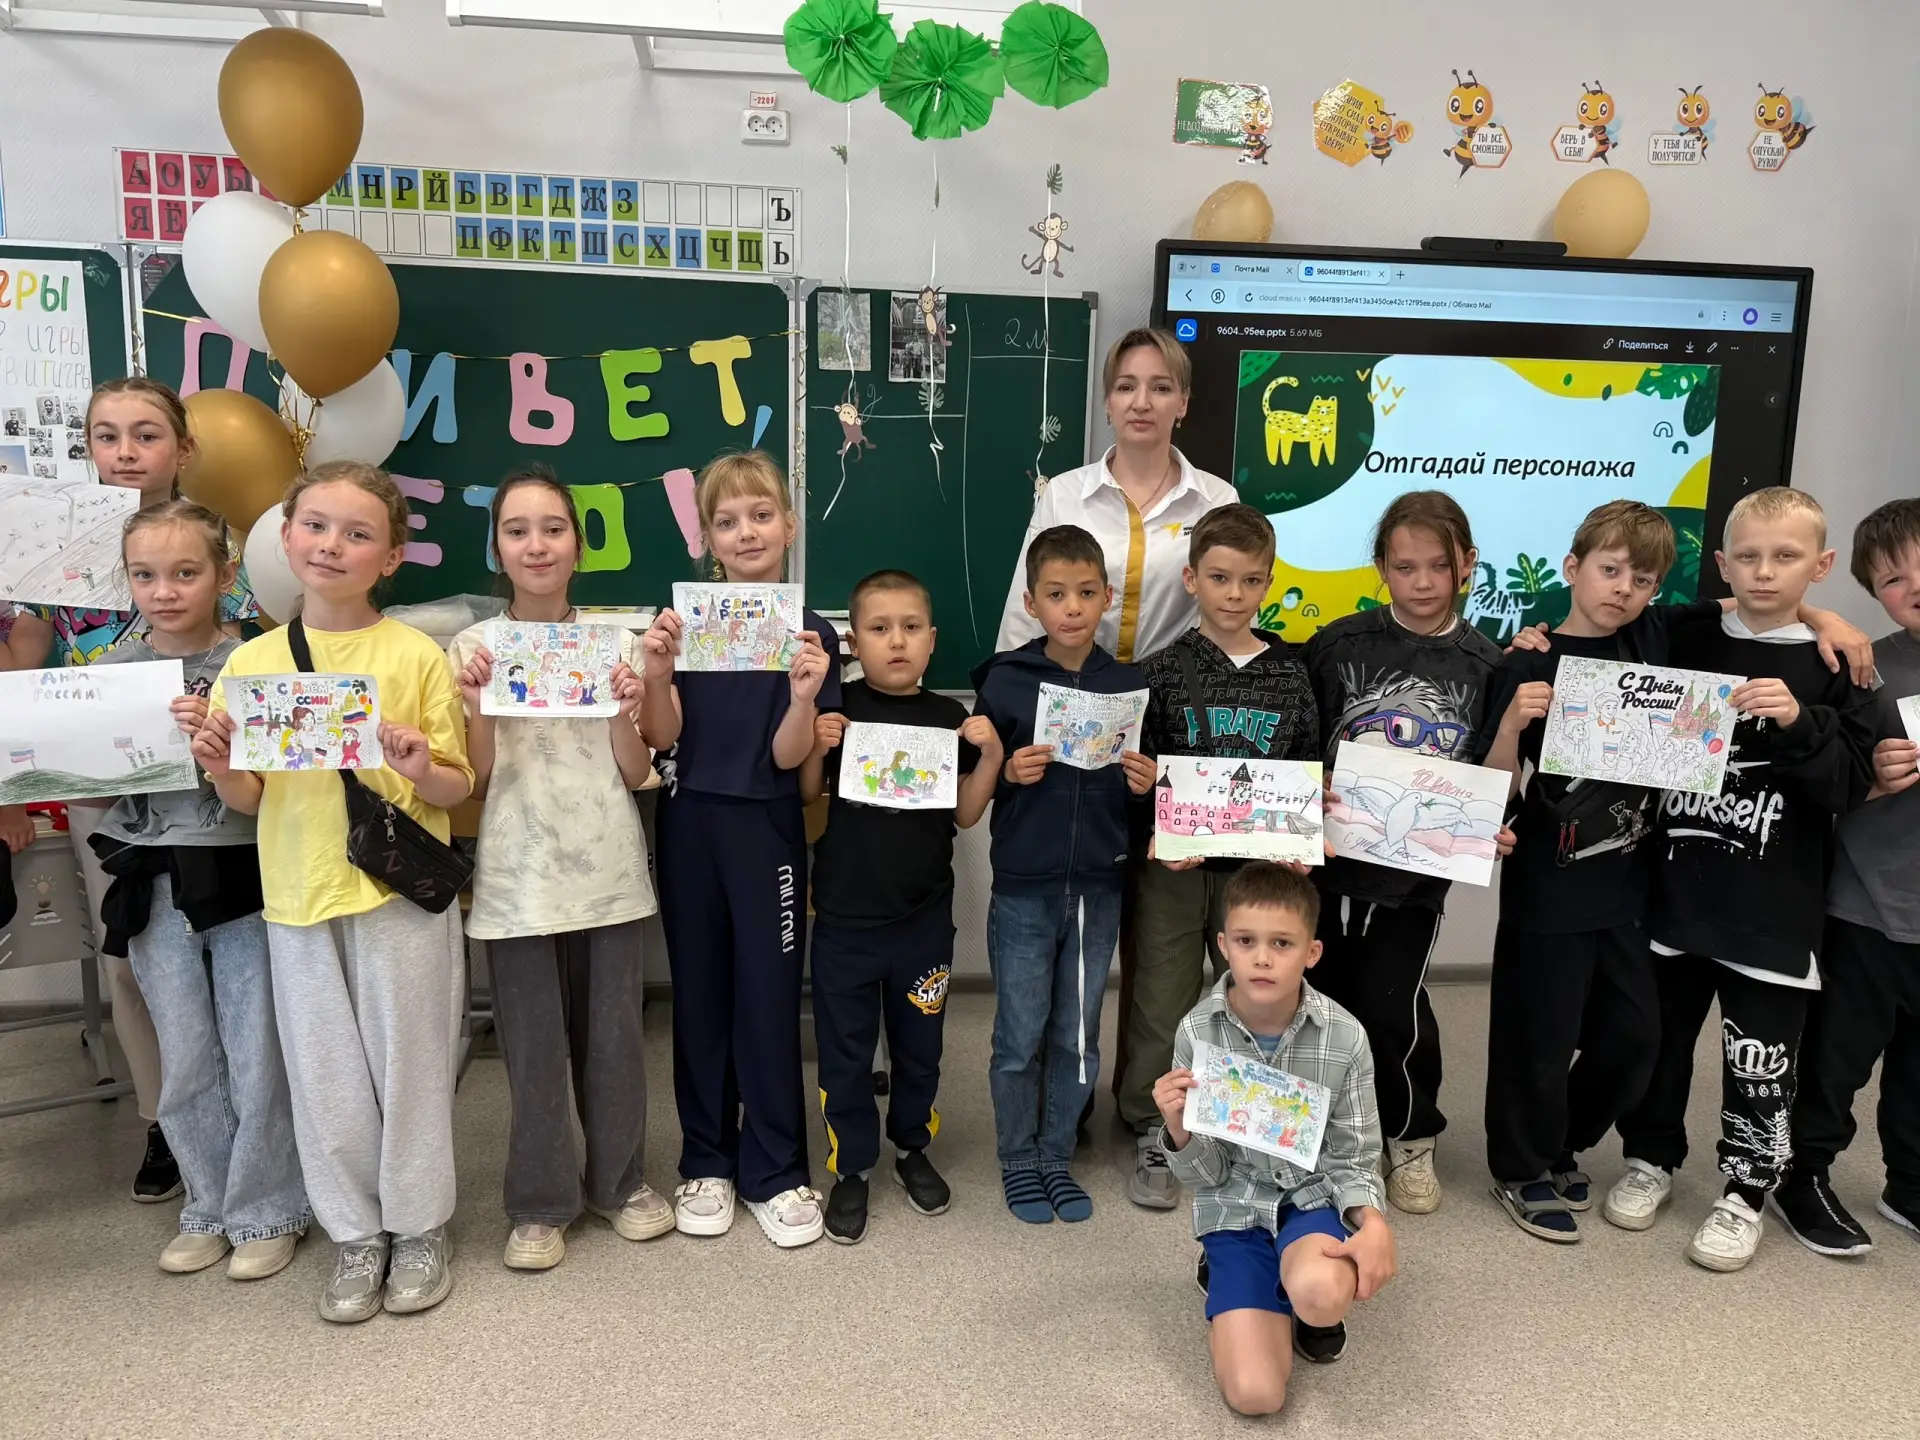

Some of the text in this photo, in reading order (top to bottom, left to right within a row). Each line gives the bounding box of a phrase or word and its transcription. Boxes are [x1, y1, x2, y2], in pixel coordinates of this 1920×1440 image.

[1478, 133, 1488, 143] ТЫ
[1560, 133, 1586, 145] ВЕРЬ В
[1763, 135, 1772, 144] НЕ
[1653, 139, 1659, 149] У
[1663, 139, 1680, 149] ТЕБЯ
[1564, 147, 1584, 157] СЕБЯ!
[1752, 146, 1785, 157] ОПУСКАЙ
[161, 161, 180, 188] О
[193, 164, 214, 189] У
[361, 173, 383, 199] Н
[396, 176, 413, 201] Р
[426, 172, 448, 203] Й
[457, 180, 476, 205] Б
[490, 181, 509, 206] В
[522, 183, 538, 208] Г
[551, 185, 571, 216] Д
[581, 186, 607, 212] Ж
[617, 188, 633, 214] З
[771, 197, 792, 222] Ъ
[129, 205, 150, 232] Я
[458, 225, 480, 250] П
[489, 226, 512, 251] Ф
[521, 227, 541, 253] К
[554, 229, 571, 254] Т
[582, 231, 607, 255] Ш
[618, 232, 635, 258] С
[647, 234, 669, 259] Х
[679, 235, 699, 266] Ц
[710, 238, 730, 262] Ч
[737, 238, 763, 270] Щ
[773, 241, 790, 265] Ь
[1234, 264, 1270, 273] Почта Mail
[1452, 300, 1478, 309] Облако
[1478, 301, 1492, 309] Mail
[1289, 328, 1307, 337] 5.69
[1618, 339, 1669, 350] Поделиться
[1364, 449, 1636, 480] Отгадай персонажа
[277, 681, 329, 696] С Днём
[1617, 671, 1685, 696] С Днём
[278, 693, 334, 708] России!
[1621, 690, 1681, 710] России!
[927, 967, 937, 976] TO
